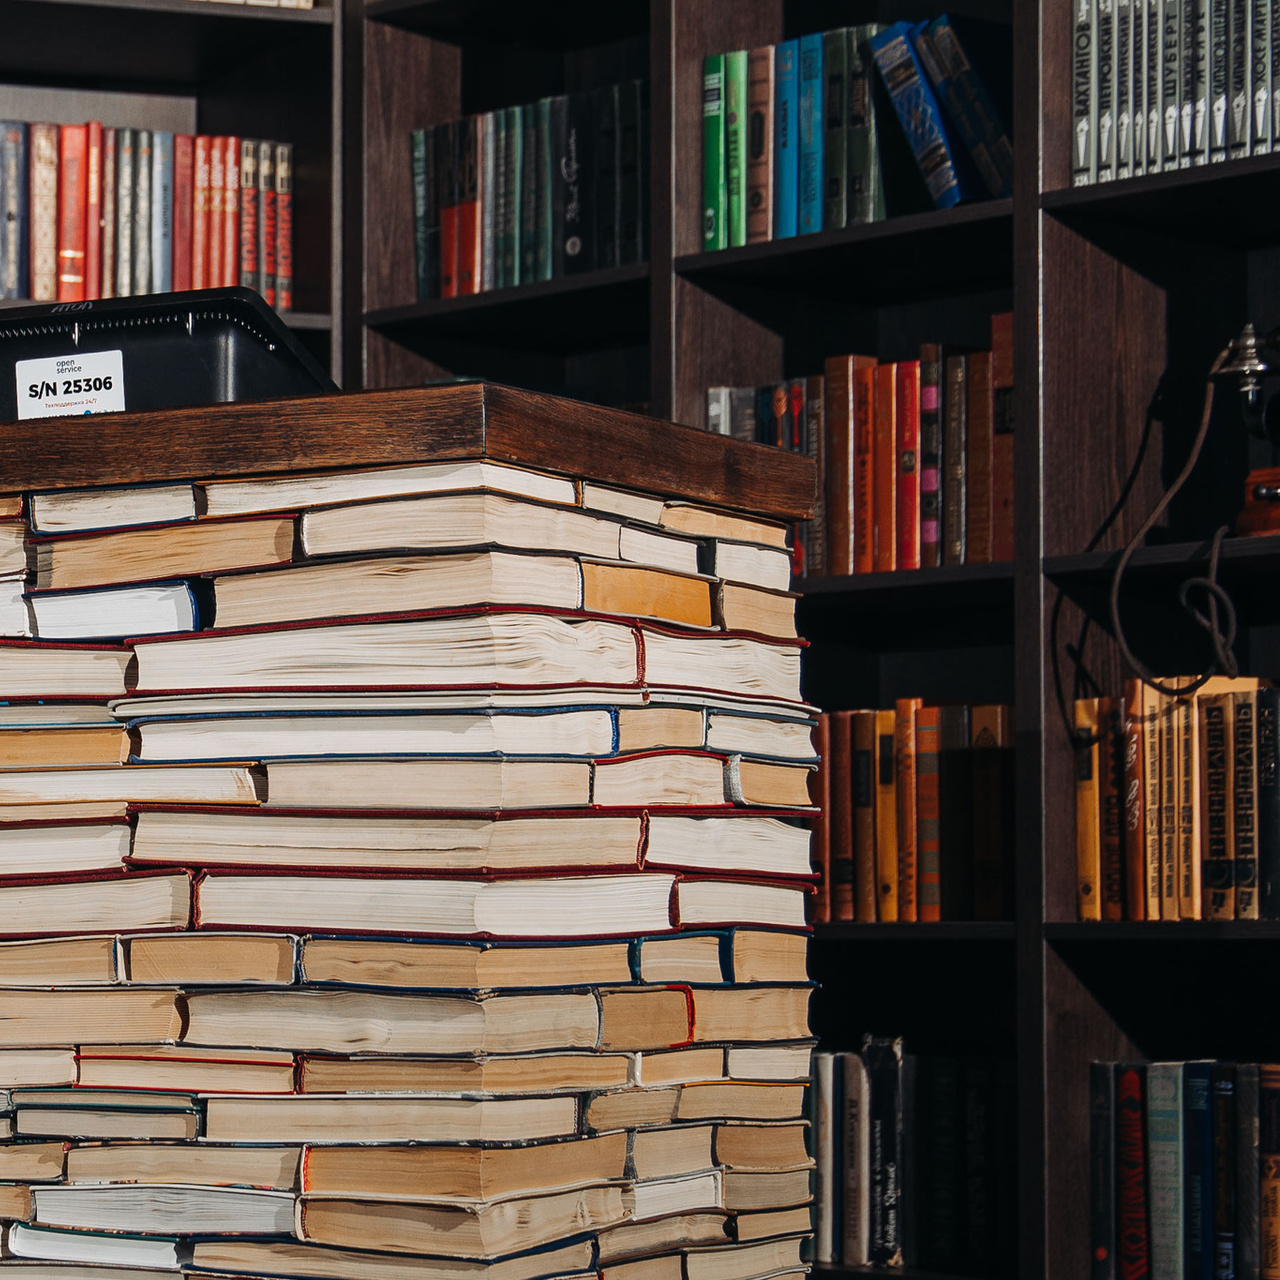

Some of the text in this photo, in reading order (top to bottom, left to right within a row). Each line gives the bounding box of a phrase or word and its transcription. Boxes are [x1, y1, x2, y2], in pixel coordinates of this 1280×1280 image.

[1074, 22, 1091, 116] ВАХТАНГОВ
[1099, 16, 1111, 109] ПЕТРОВСКИЙ
[1165, 13, 1177, 98] ШУБЕРТ
[1255, 47, 1267, 84] ХОСЕ
[28, 376, 113, 400] S/N 25306
[56, 359, 75, 368] open
[56, 365, 82, 374] service
[1204, 706, 1233, 890] СТЕНДАЛЬ
[1236, 703, 1256, 889] СТЕНДАЛЬ
